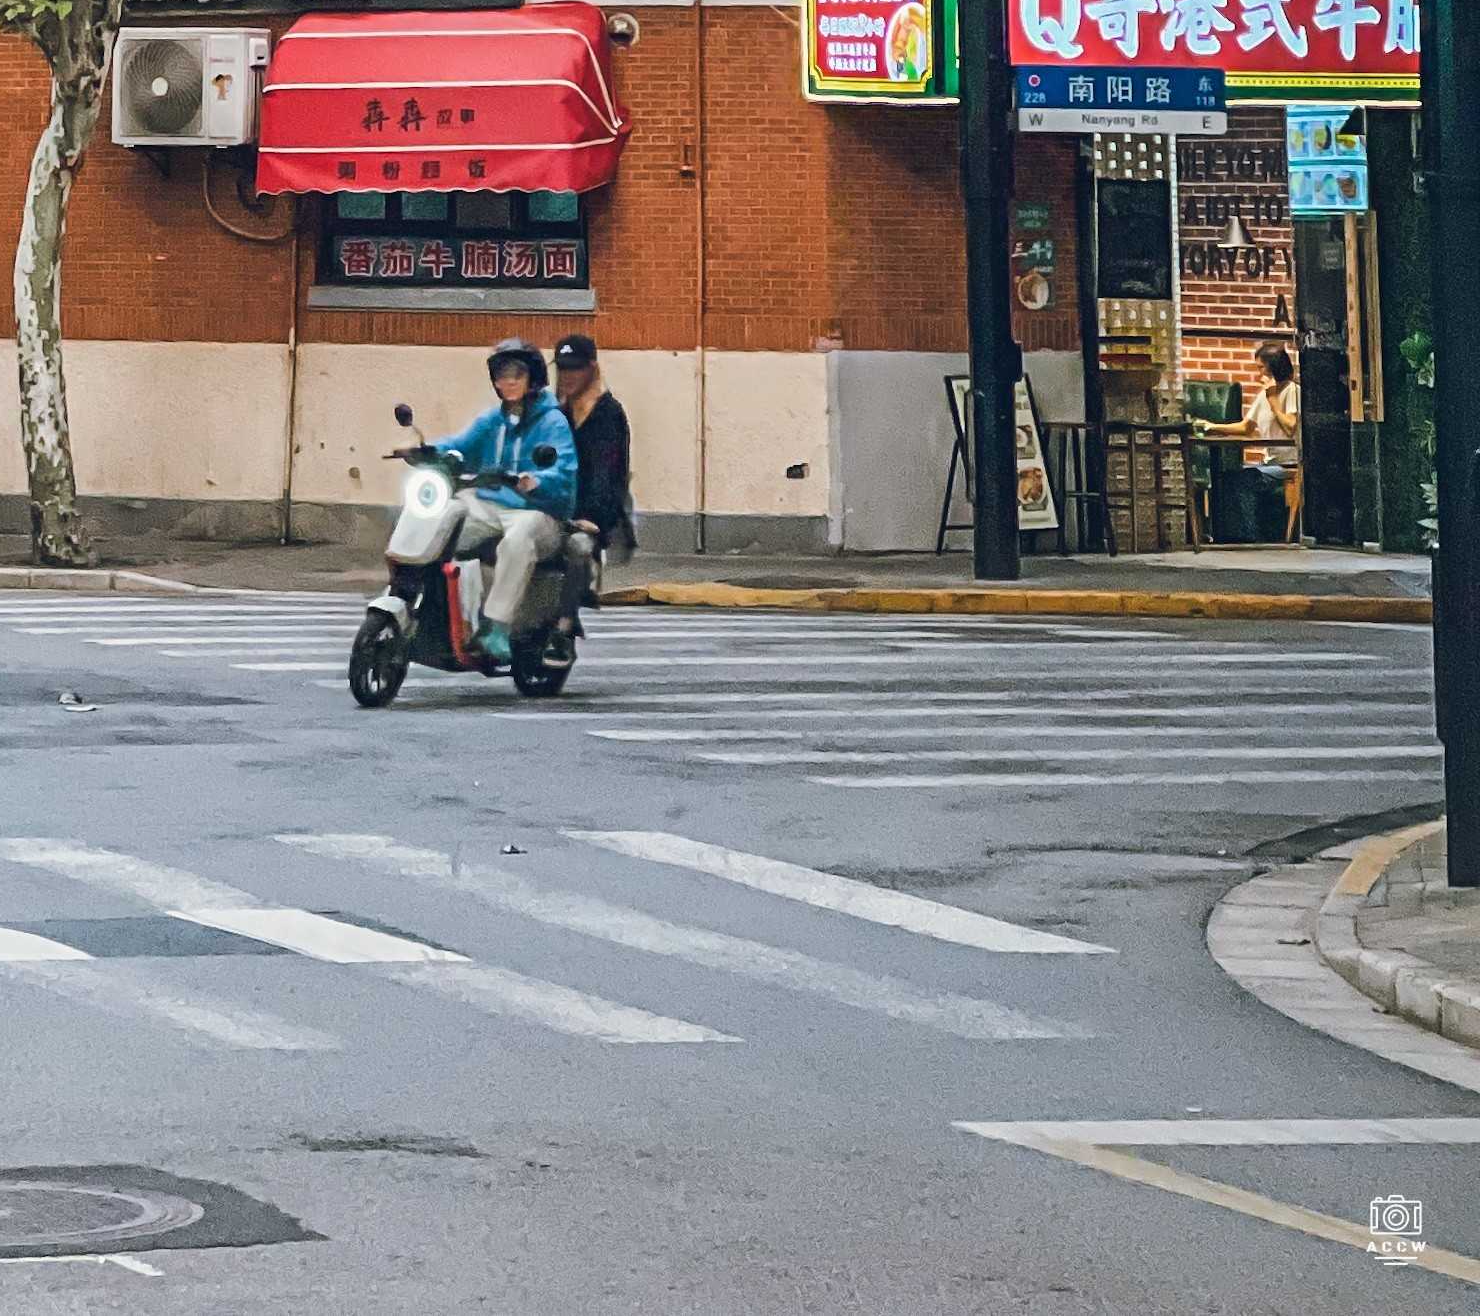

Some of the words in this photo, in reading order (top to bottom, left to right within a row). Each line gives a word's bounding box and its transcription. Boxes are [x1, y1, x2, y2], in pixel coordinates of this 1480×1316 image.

[1068, 74, 1172, 104] 南阳路
[1198, 76, 1213, 92] 东
[1023, 92, 1046, 104] 228
[1196, 95, 1216, 106] 118
[1028, 114, 1044, 126] W
[1081, 113, 1135, 128] Nanyang
[1141, 114, 1159, 125] Rd
[1202, 116, 1212, 129] E
[340, 239, 578, 279] 番茄牛腩汤面
